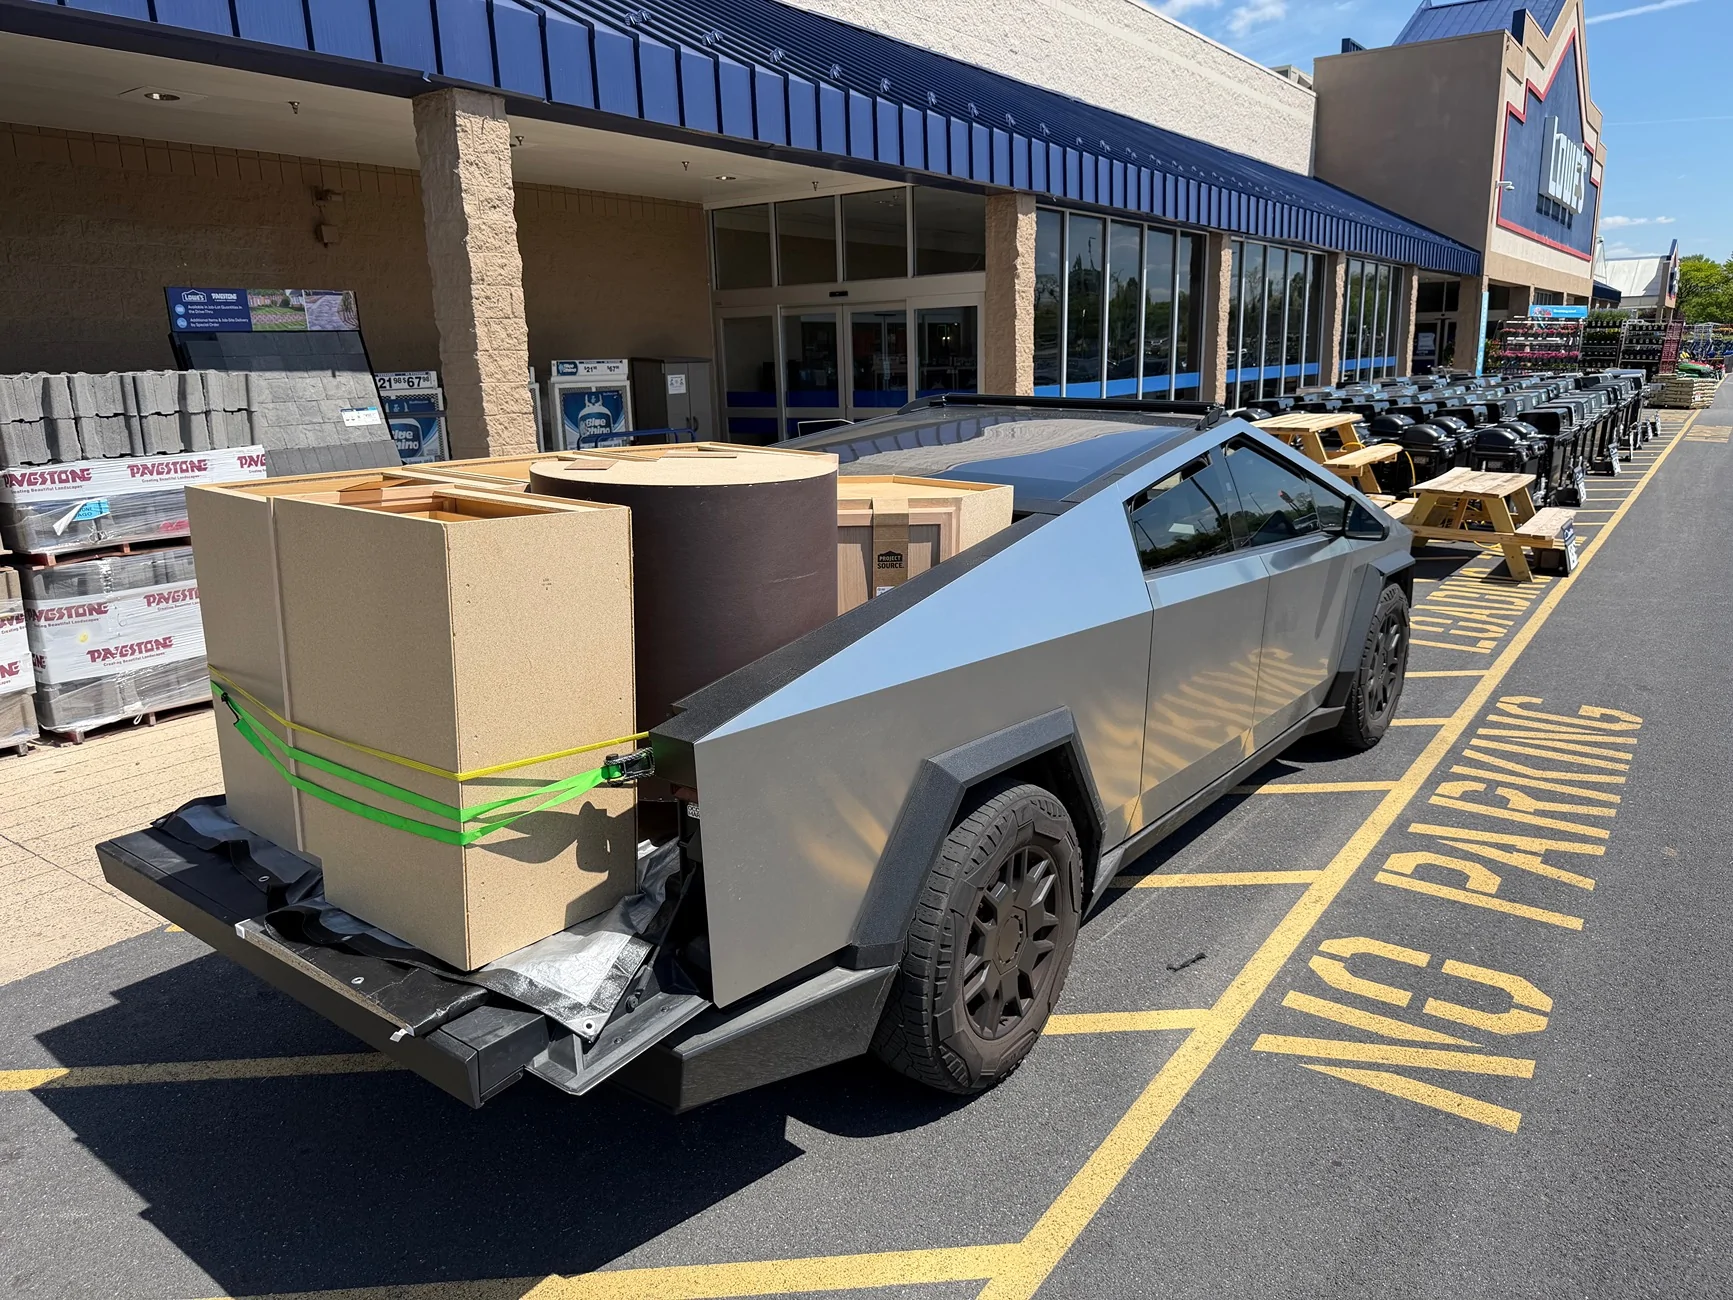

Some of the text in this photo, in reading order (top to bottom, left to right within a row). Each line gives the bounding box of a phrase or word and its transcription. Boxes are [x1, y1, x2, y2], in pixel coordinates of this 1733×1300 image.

[392, 430, 414, 440] lue
[2, 467, 92, 489] PAVESTONE
[127, 459, 209, 478] PAVESTONE
[86, 635, 174, 663] PAVESTONE
[1251, 695, 1644, 1135] NO PARKING
